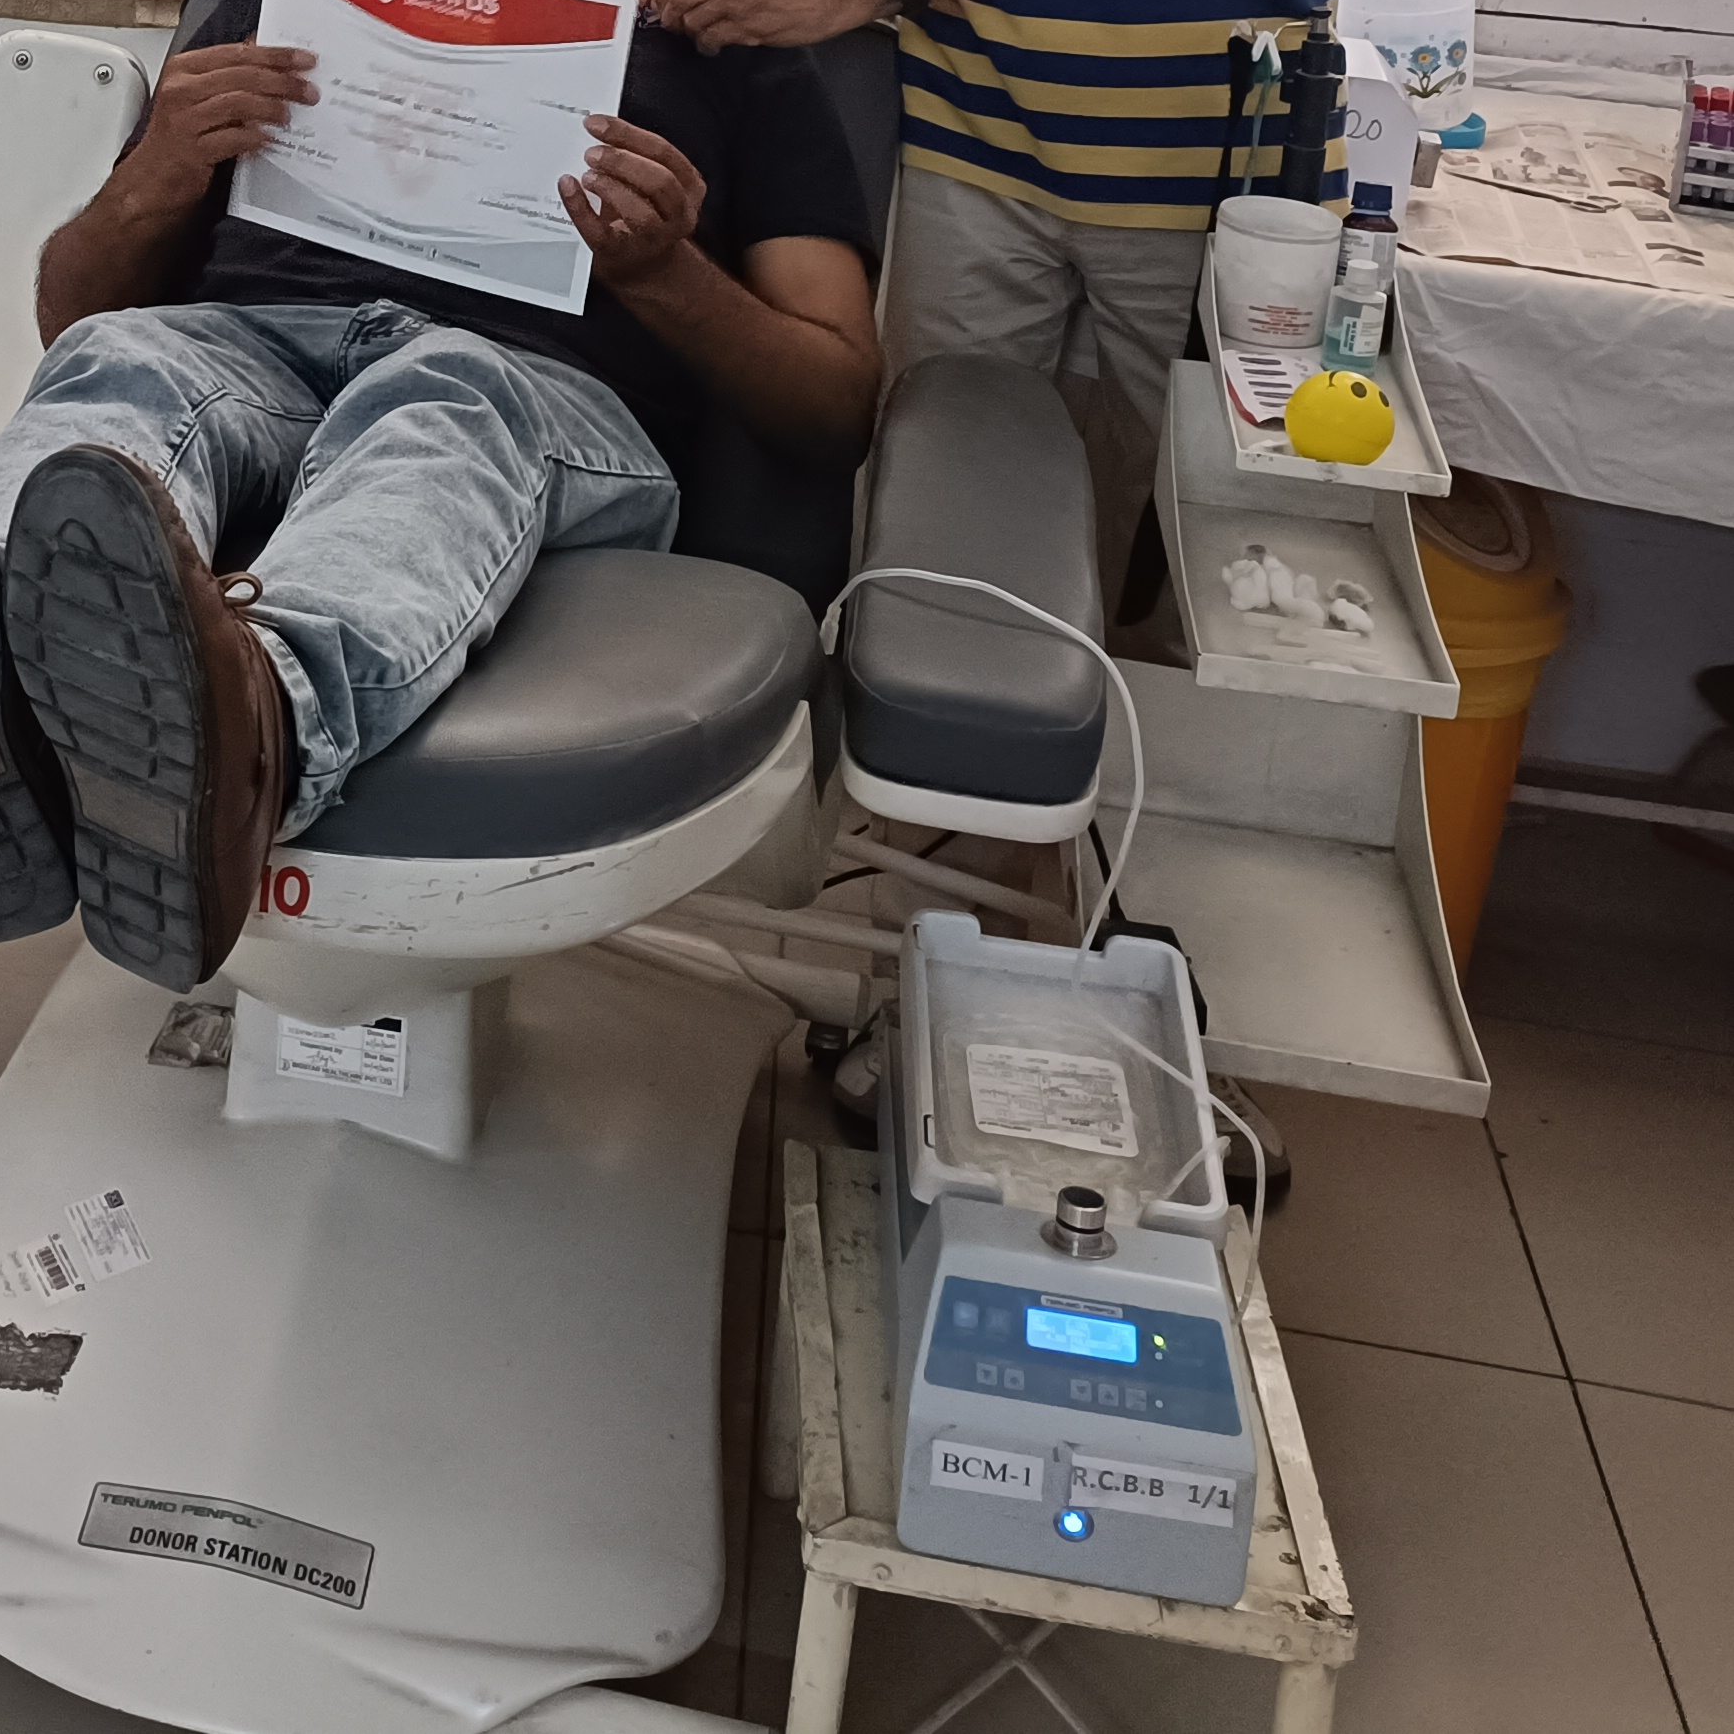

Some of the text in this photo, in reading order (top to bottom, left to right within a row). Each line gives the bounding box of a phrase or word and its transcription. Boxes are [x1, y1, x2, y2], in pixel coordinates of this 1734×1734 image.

[1346, 109, 1382, 141] 20
[941, 1452, 1031, 1487] BCM-1
[100, 1492, 177, 1513] TERUMO
[1072, 1466, 1232, 1509] R.C.B.B 1/1
[129, 1526, 356, 1607] DONOR STATION DC200
